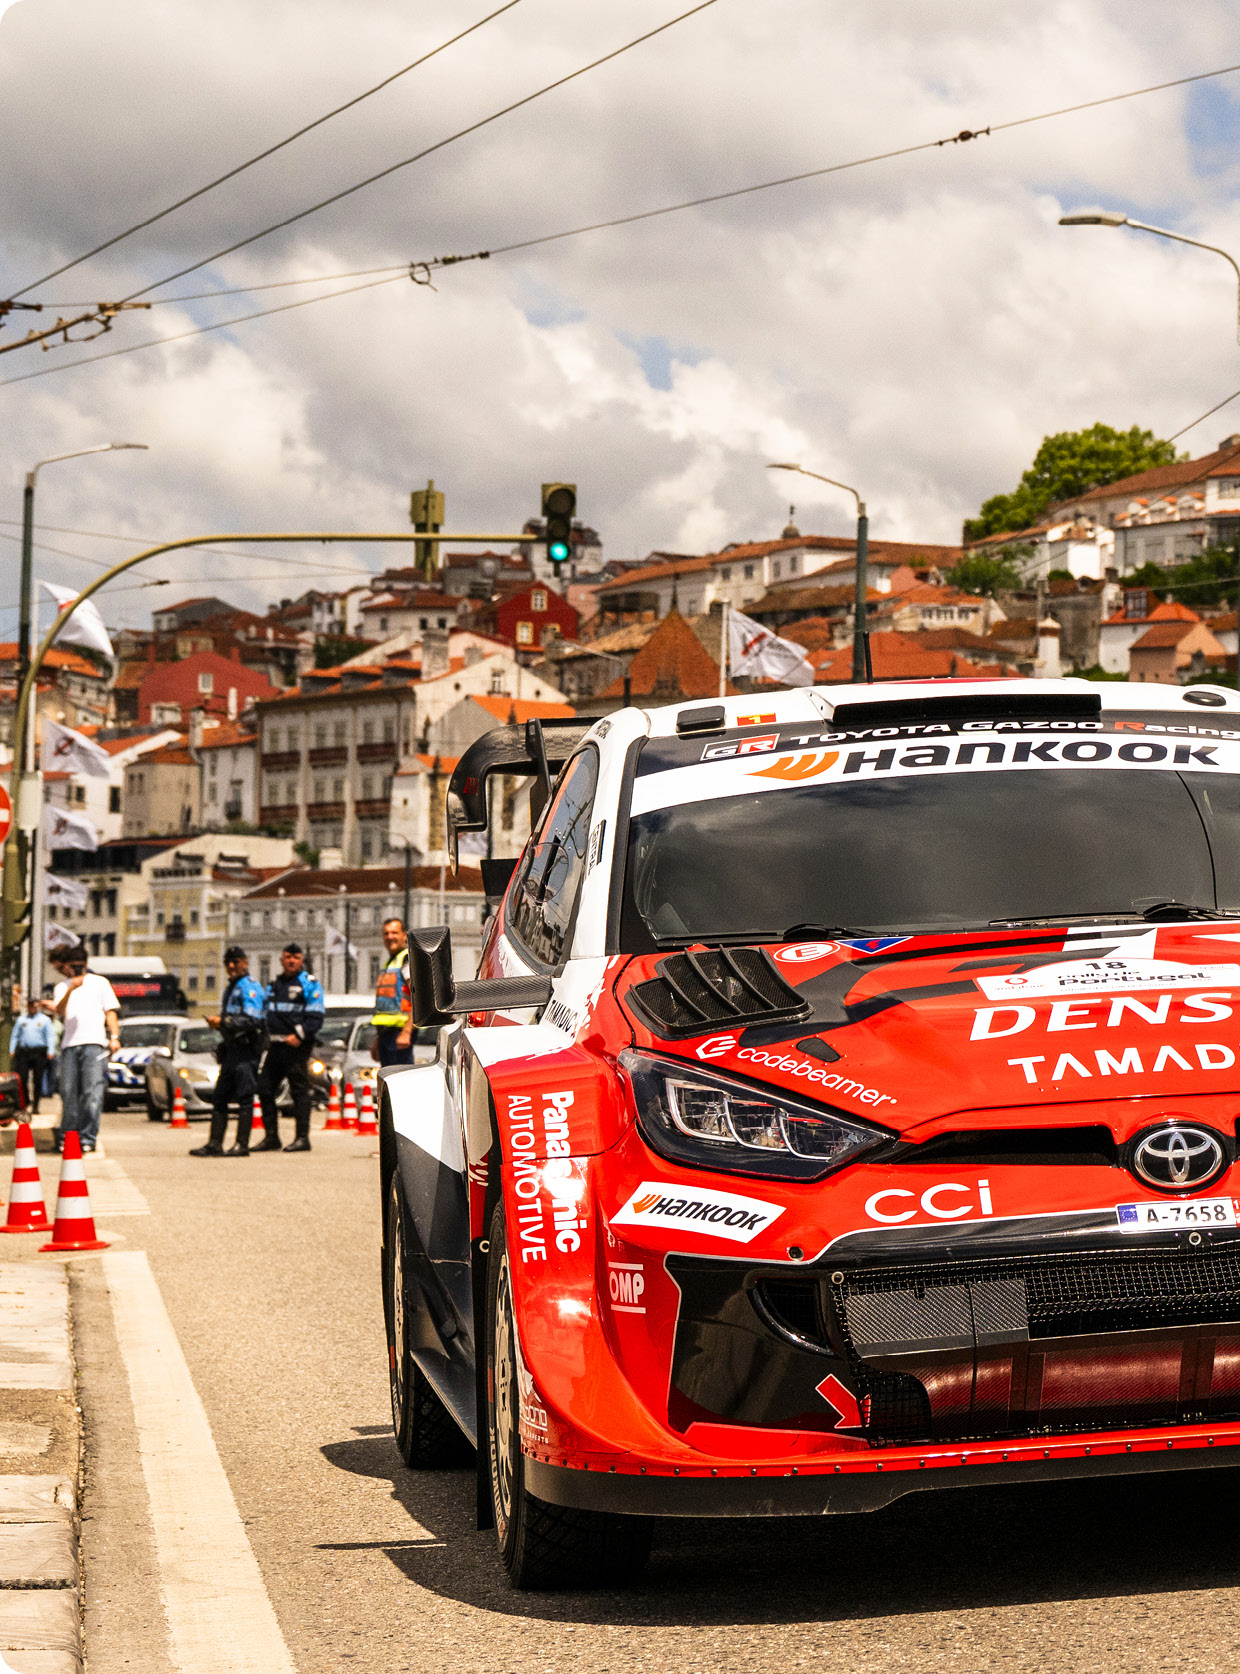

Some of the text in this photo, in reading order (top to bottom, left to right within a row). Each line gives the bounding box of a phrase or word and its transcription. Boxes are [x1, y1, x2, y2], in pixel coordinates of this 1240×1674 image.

[790, 723, 952, 745] TOYOTA
[962, 721, 1104, 732] GAZOO
[703, 738, 777, 759] GR
[1058, 972, 1211, 986] Portugal
[1085, 961, 1127, 970] 18
[544, 999, 579, 1032] TAMADIC
[737, 1047, 892, 1107] codebeamer
[507, 1095, 547, 1263] AUTOMOTIVE
[864, 1179, 993, 1223] CCi
[1147, 1204, 1227, 1223] A-7658
[609, 1271, 645, 1304] OMP
